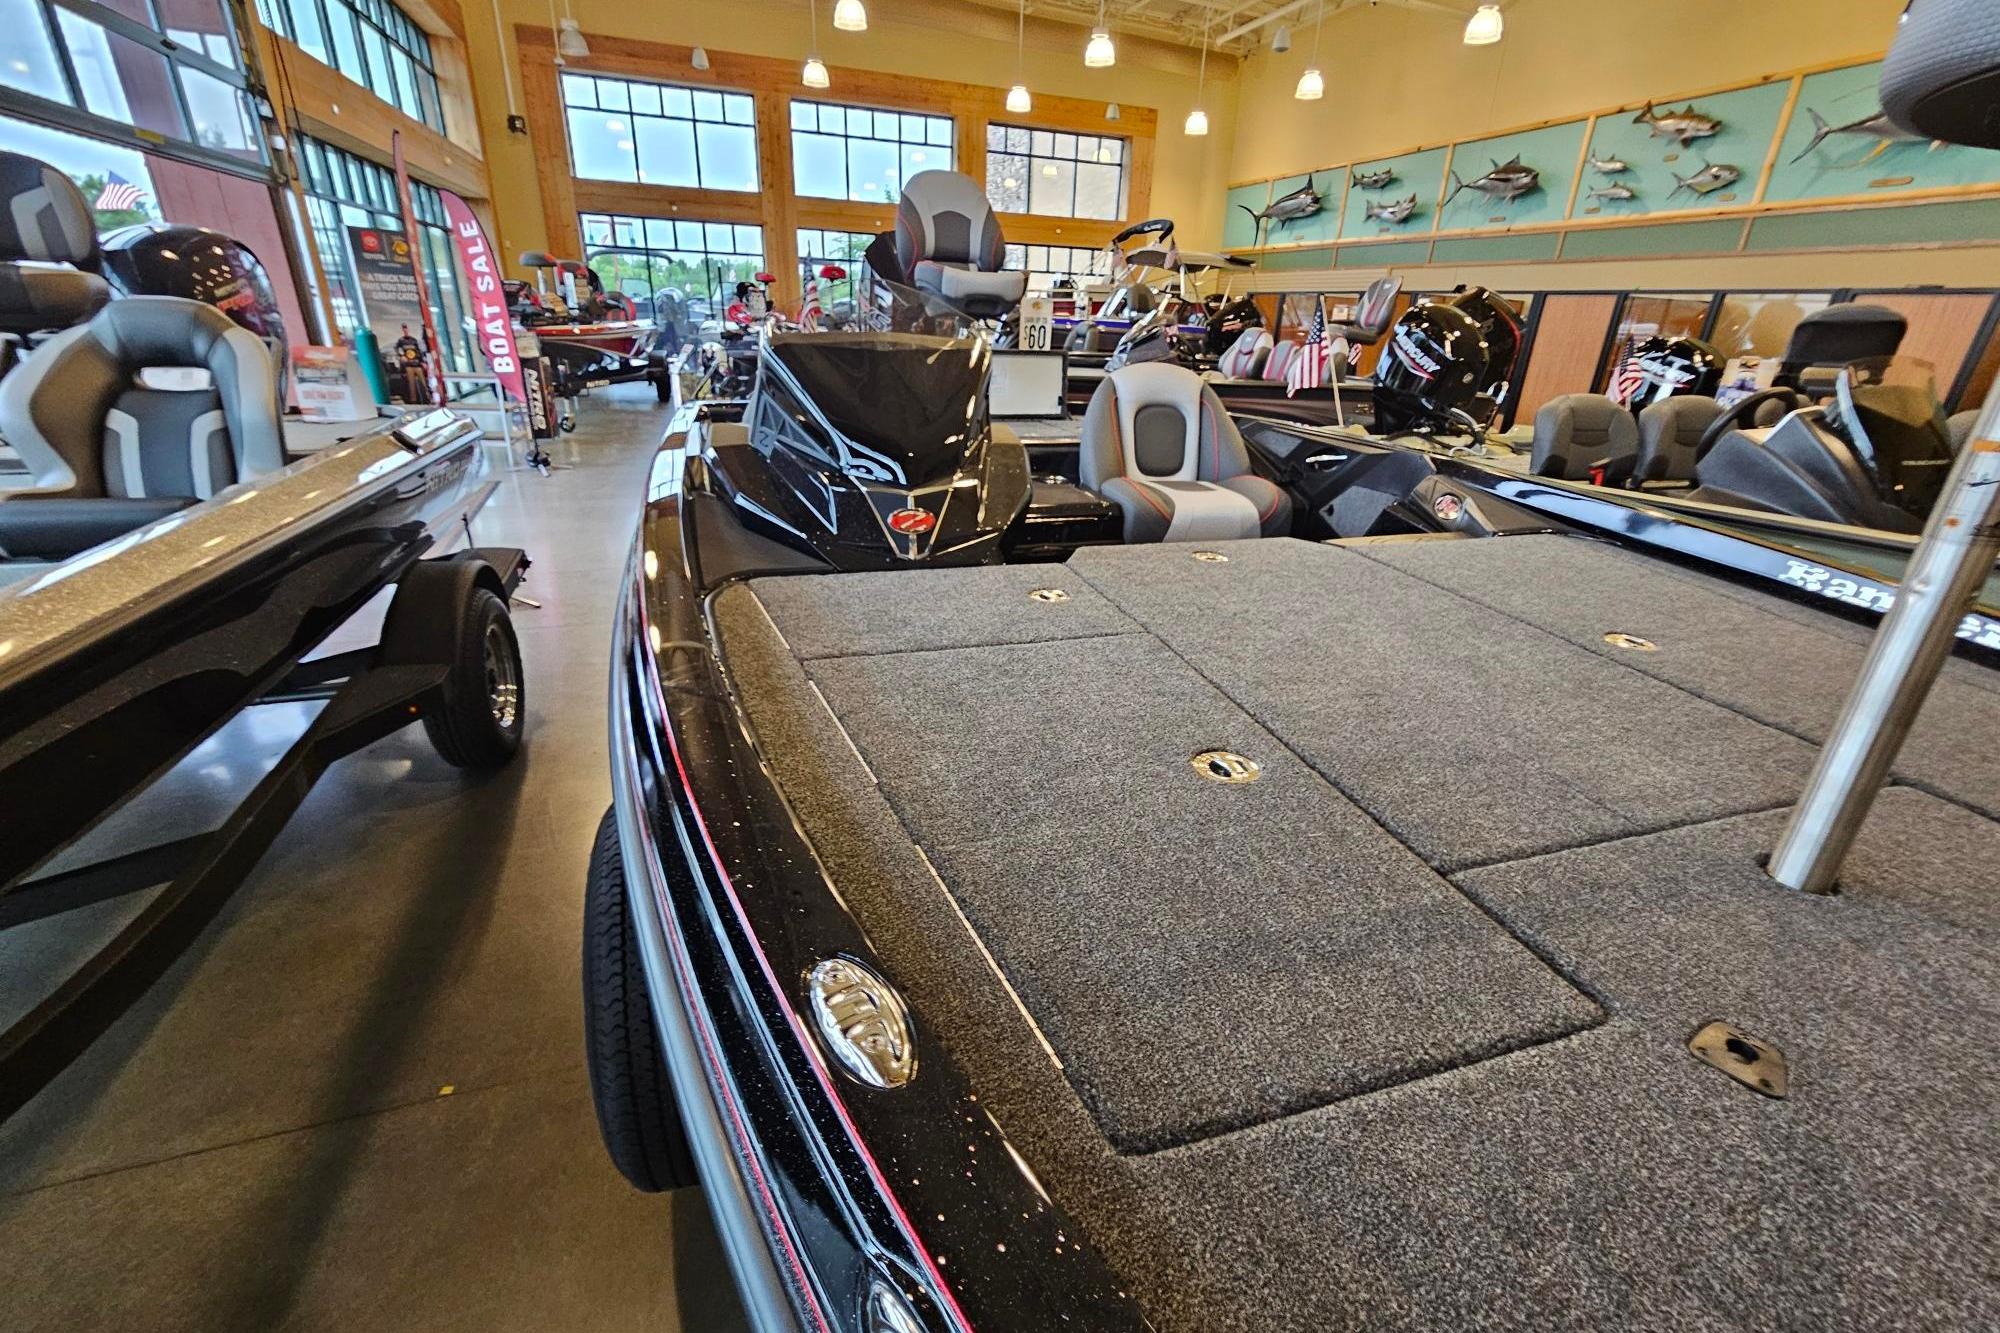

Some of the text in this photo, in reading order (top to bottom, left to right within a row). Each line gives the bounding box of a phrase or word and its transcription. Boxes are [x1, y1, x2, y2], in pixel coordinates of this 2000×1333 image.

[459, 218, 516, 373] BOAT SALE
[1024, 325, 1047, 349] $60
